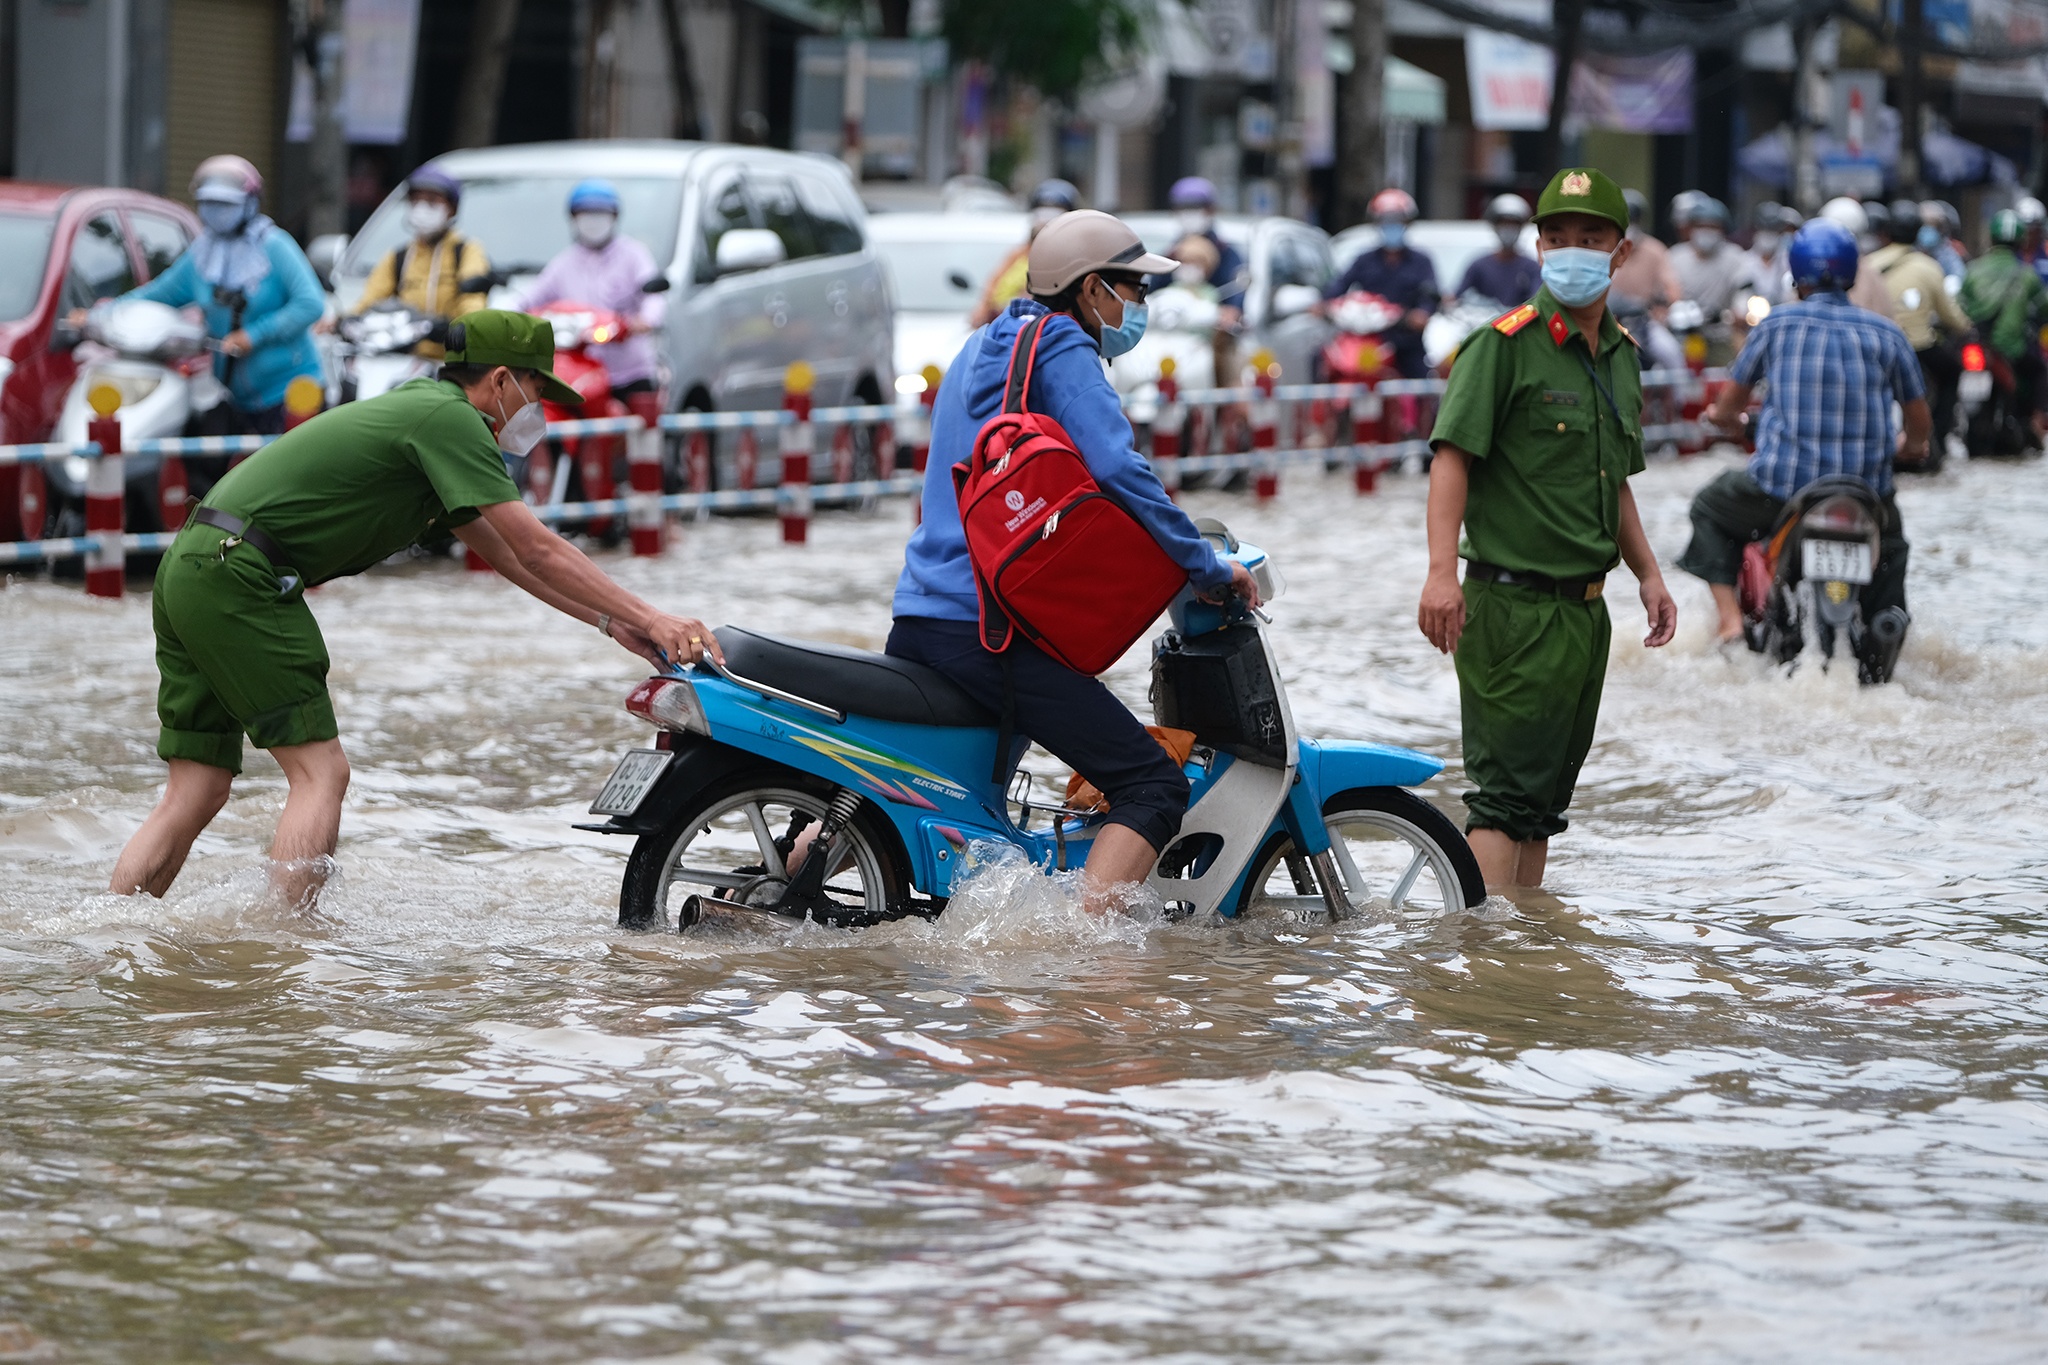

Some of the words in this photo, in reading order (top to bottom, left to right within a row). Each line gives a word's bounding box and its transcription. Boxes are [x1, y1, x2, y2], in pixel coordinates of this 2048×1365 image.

[599, 783, 643, 810] 0298
[912, 777, 945, 793] ELECTRIC
[944, 788, 967, 801] START
